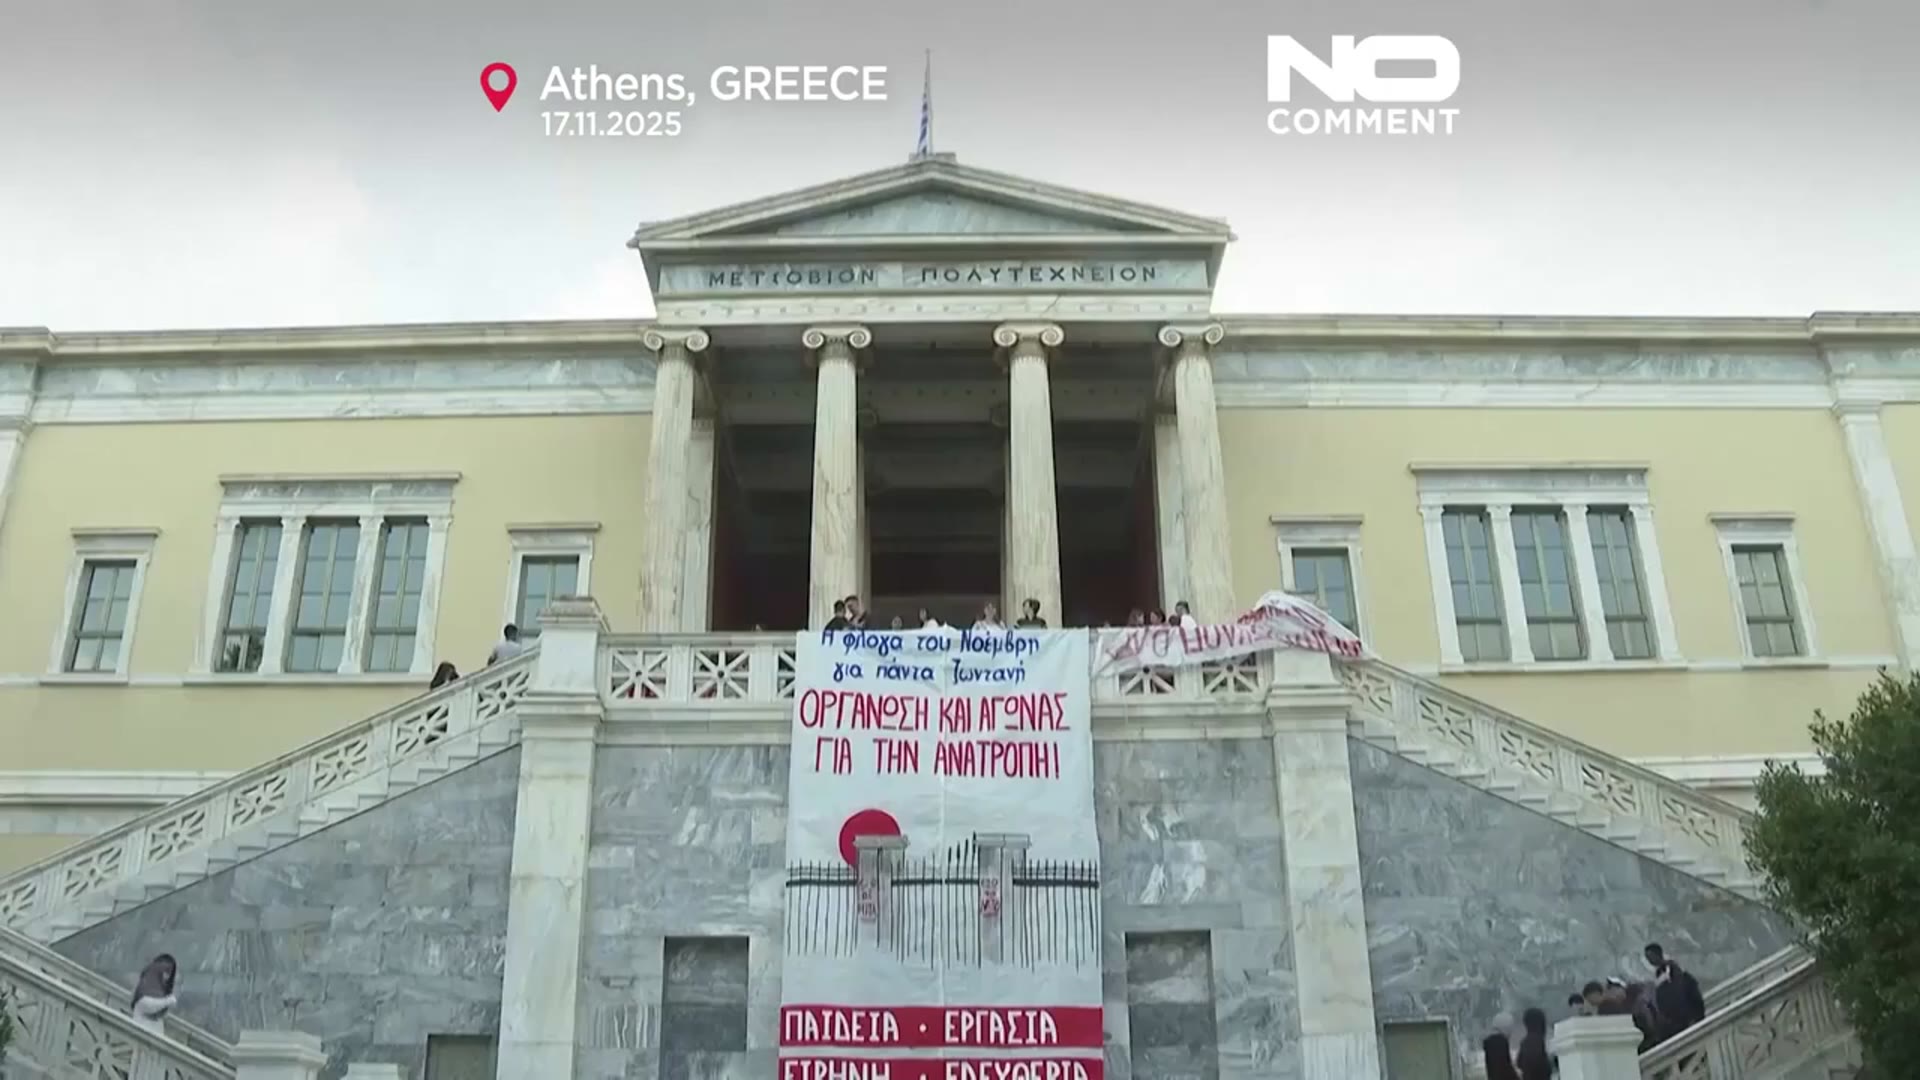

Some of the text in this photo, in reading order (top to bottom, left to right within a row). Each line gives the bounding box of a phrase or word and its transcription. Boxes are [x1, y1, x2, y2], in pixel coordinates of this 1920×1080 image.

[921, 266, 1157, 283] ΠΟΛΥΤΕΧΝΕΙΟΝ
[917, 635, 951, 652] του
[833, 661, 863, 683] για
[876, 656, 935, 681] πάντα
[799, 689, 1071, 733] ΟΡΓΑΝΩΣΗ ΚΑΙ ΑΓΩΝΑΣ
[815, 737, 1060, 780] ΓΙΑ ΤΗΝ ΑΝΑΤΡΟΠΗ!
[784, 1009, 1058, 1044] ΠΑΙΔΕΙΑ ΕΡΓΑΣΙΑ
